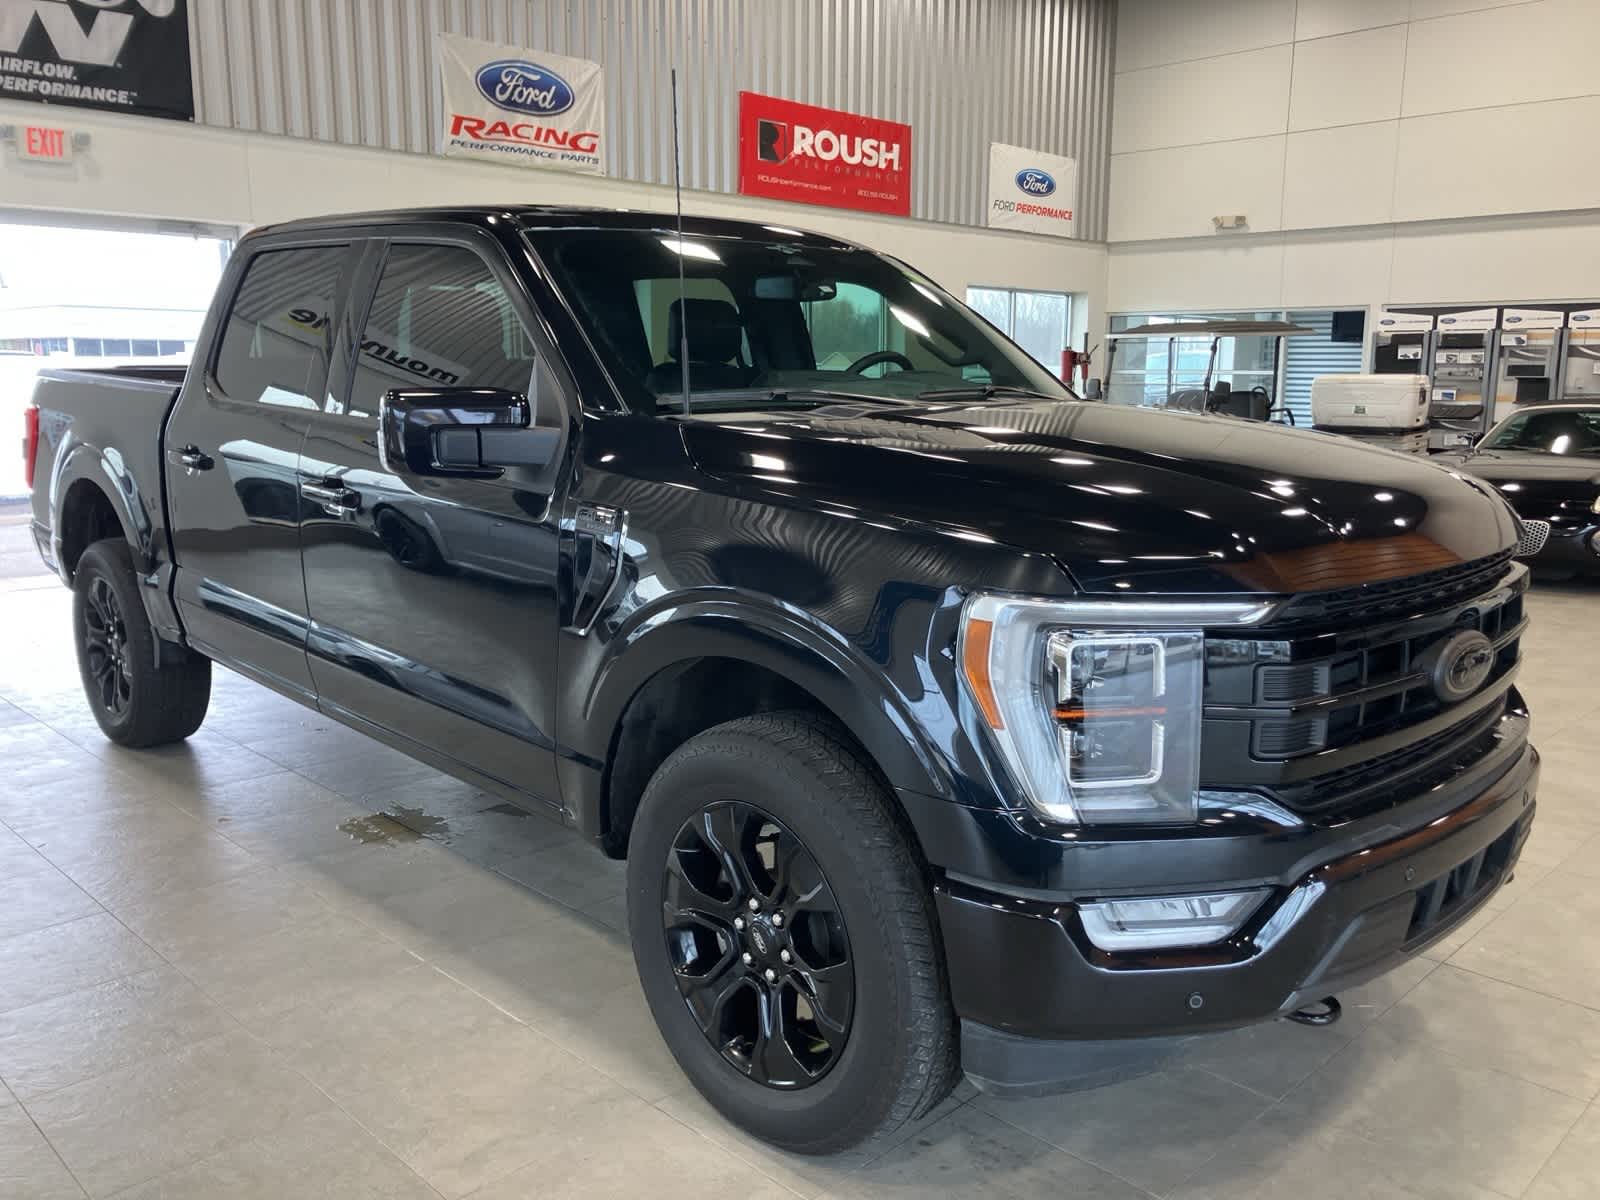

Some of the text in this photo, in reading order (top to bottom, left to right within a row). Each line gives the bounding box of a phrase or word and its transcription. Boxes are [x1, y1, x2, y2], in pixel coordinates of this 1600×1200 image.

[495, 67, 557, 109] Ford
[26, 125, 65, 159] EXIT
[450, 114, 600, 153] RACING
[793, 124, 900, 171] ROUSH
[450, 138, 600, 166] PERFORMANCE PARTS
[1023, 172, 1049, 193] Ford
[993, 199, 1073, 221] FORD PERFORMANCE
